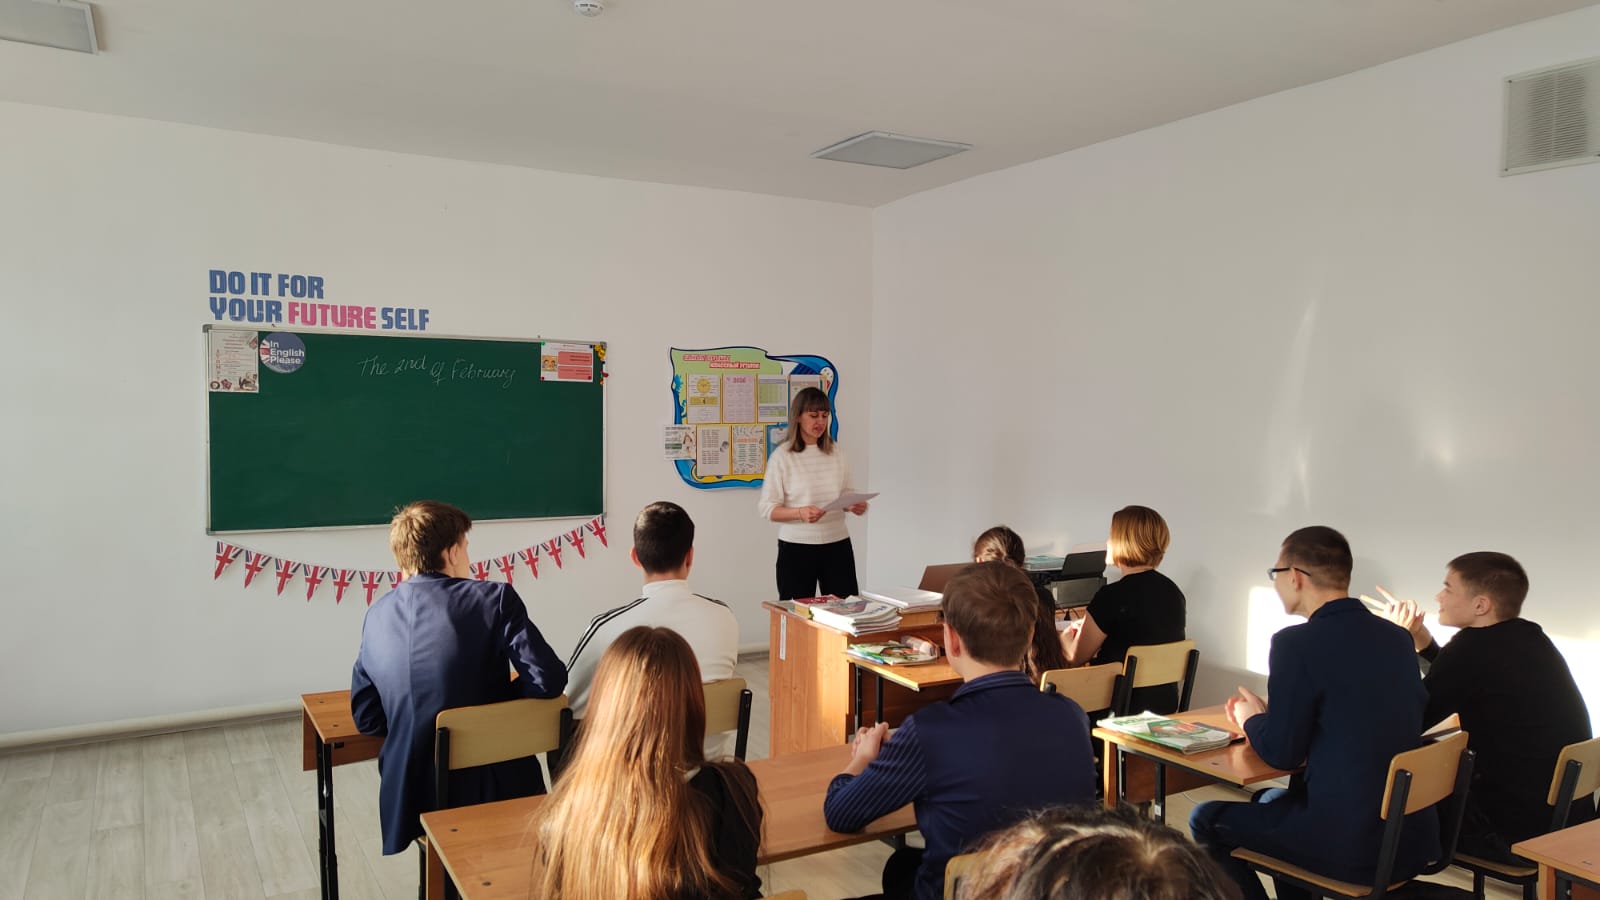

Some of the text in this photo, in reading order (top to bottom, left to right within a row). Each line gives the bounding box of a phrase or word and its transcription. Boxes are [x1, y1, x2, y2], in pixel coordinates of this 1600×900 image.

[209, 269, 324, 299] DO IT FOR
[209, 297, 430, 331] YOUR FUTURE SELF
[270, 340, 279, 348] In
[270, 348, 305, 358] English
[357, 355, 517, 389] The 2nd of February
